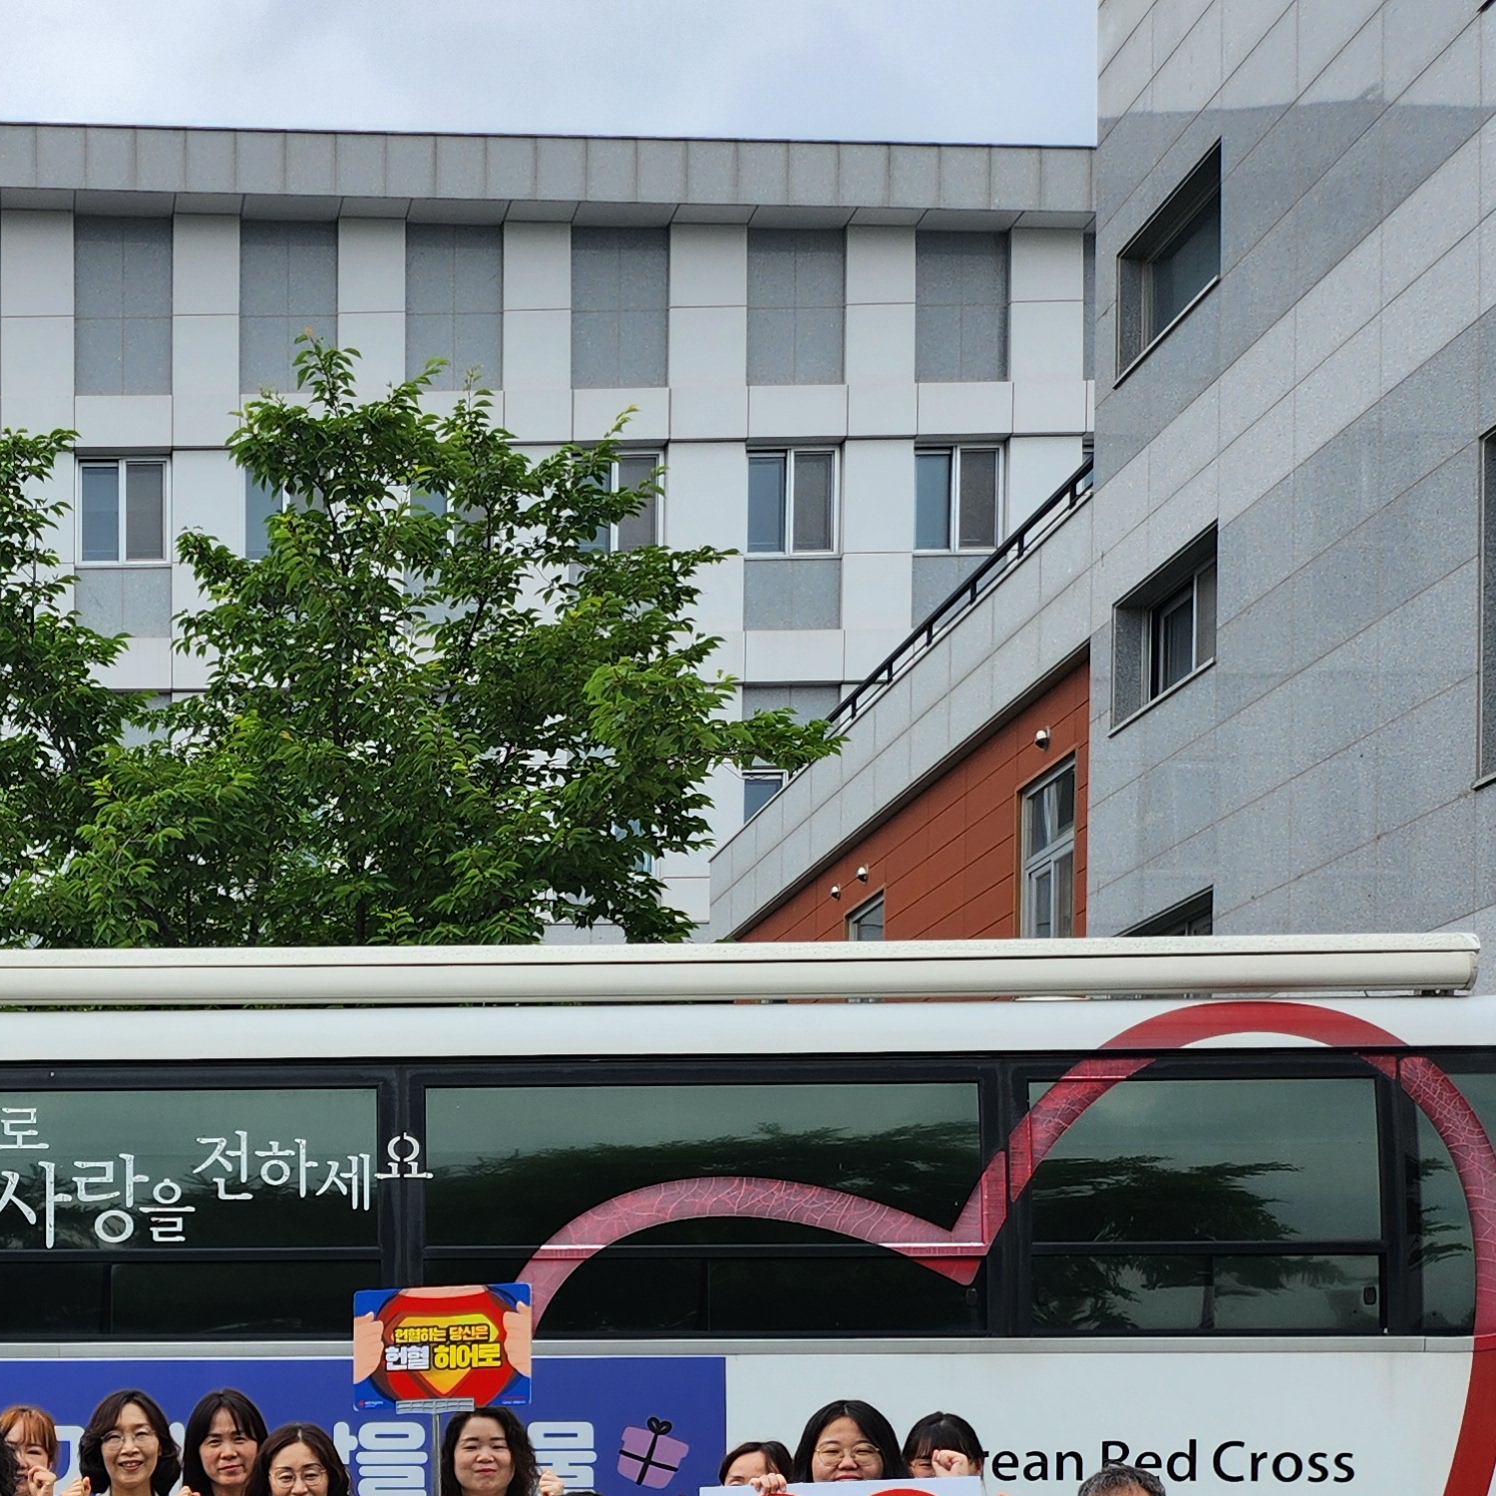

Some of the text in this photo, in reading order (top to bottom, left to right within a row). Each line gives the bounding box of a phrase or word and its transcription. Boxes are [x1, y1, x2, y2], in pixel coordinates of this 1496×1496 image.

[192, 1130, 434, 1211] 전하세요
[394, 1325, 490, 1343] 헌혈하는 당신은
[385, 1343, 502, 1371] 헌혈 히어로
[983, 1438, 1356, 1483] ean Red Cross
